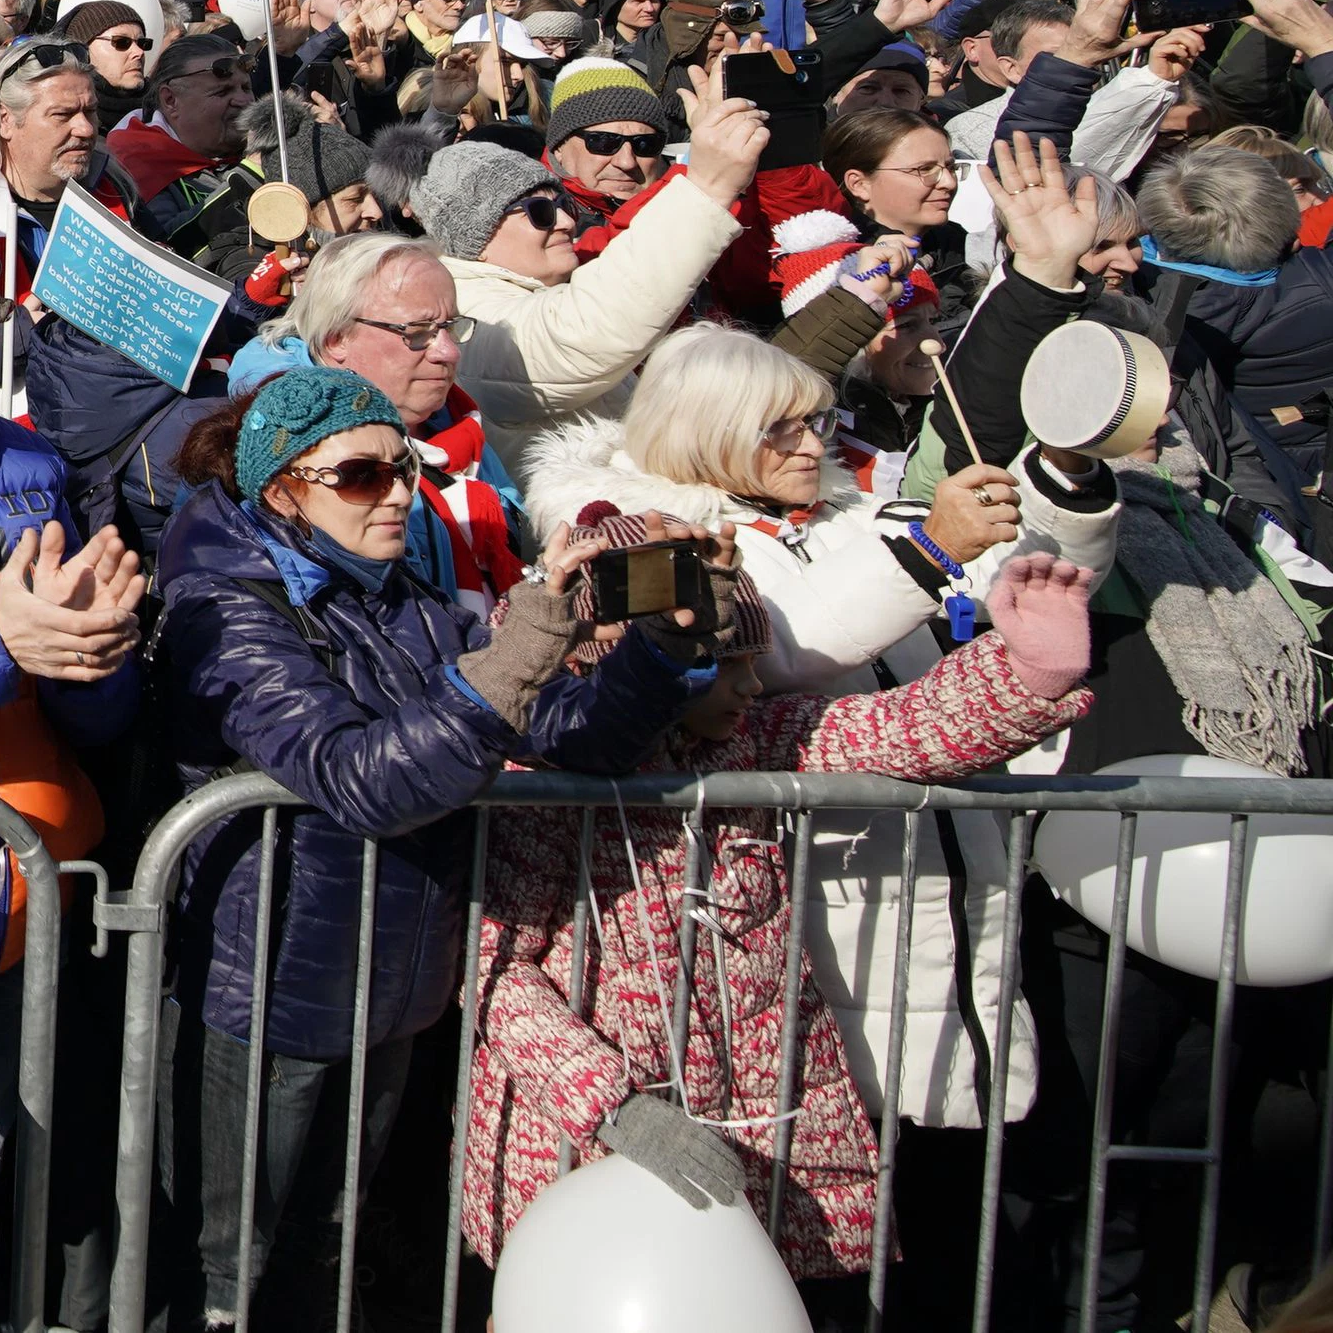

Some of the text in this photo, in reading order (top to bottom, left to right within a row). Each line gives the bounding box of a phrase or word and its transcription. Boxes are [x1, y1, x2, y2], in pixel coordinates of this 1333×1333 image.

[47, 264, 115, 319] behandelt
[59, 234, 194, 335] eine Epidemie geben
[63, 224, 90, 248] eine
[162, 296, 200, 320] oder
[70, 212, 205, 309] Wenn es WIRKLICH
[42, 287, 115, 342] GESUNDEN
[61, 262, 174, 347] würden KRANKE
[71, 299, 96, 321] und
[99, 318, 136, 343] nicht
[140, 341, 160, 361] die
